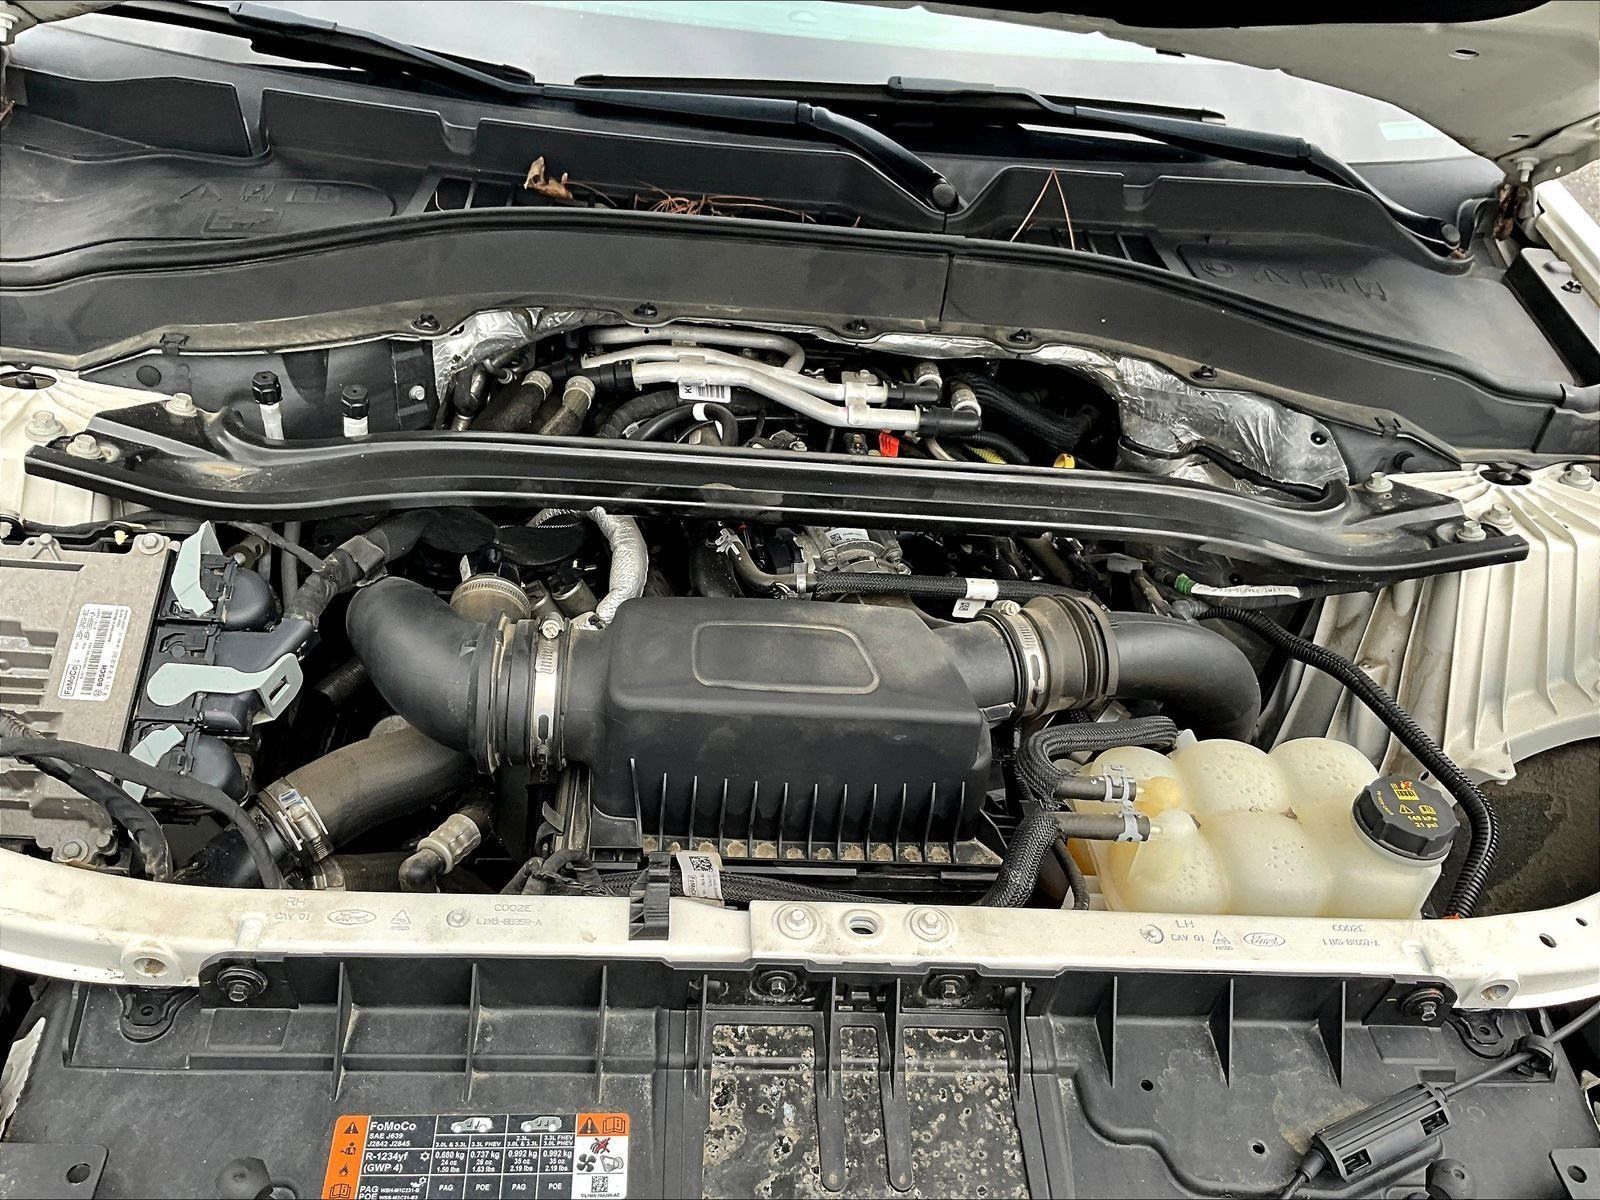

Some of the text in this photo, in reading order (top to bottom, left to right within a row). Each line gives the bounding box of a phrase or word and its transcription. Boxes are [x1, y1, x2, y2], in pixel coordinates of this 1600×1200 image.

[63, 665, 78, 695] FoMoCo
[96, 664, 107, 687] BOSCH
[287, 897, 305, 906] RH
[1175, 919, 1195, 929] LH
[370, 1121, 417, 1131] FoMoCo
[365, 1152, 409, 1162] R-1234yf
[435, 1150, 465, 1160] 0.680 kg
[470, 1150, 500, 1160] 0.737 kg
[508, 1149, 538, 1159] 0.992 kg
[563, 1149, 573, 1159] kg
[363, 1163, 403, 1174] (GWP 4)
[359, 1185, 379, 1193] PAG
[511, 1183, 527, 1191] PAG
